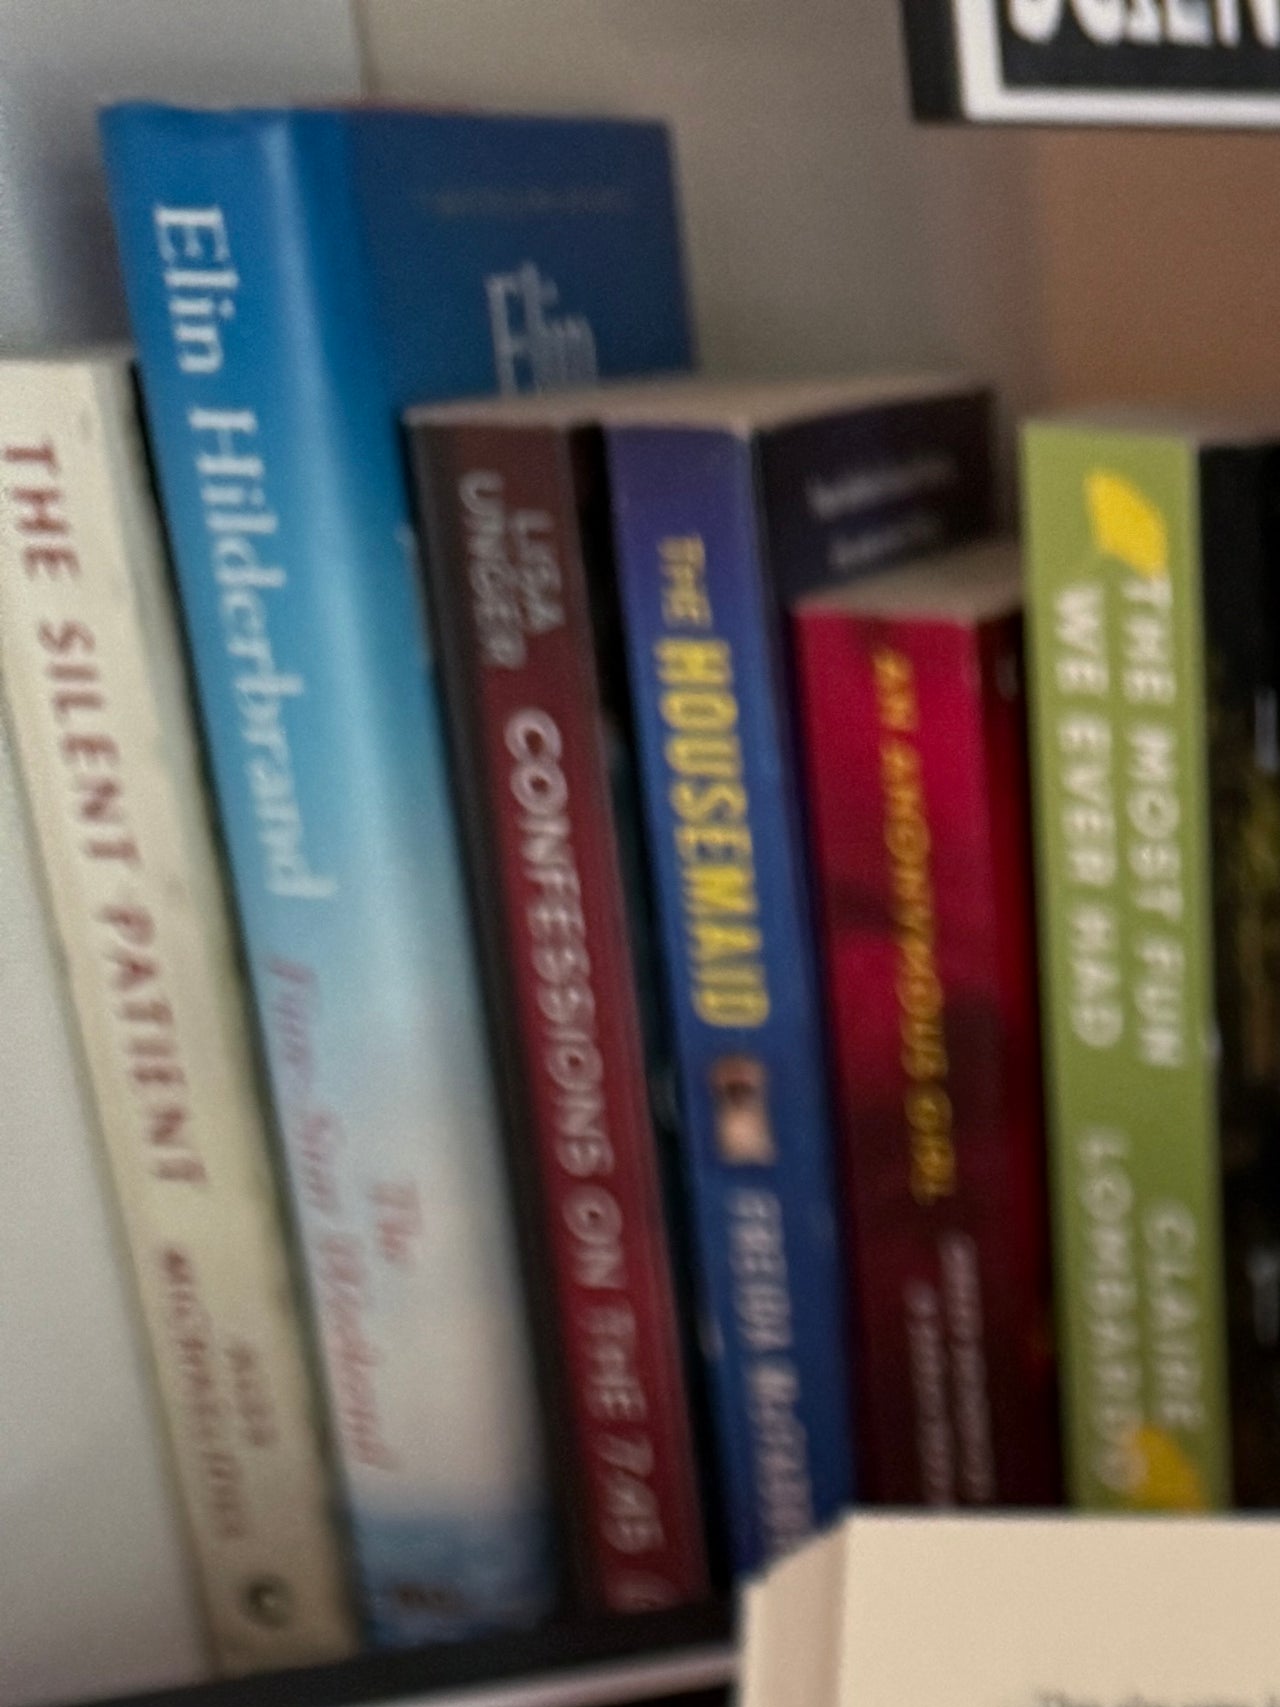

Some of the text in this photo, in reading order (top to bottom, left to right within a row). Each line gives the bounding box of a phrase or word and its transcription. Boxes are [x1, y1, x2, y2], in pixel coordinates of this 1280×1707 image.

[153, 194, 340, 910] Elin Hilderbrand
[657, 533, 765, 1032] THE HOUSEMAID
[2, 432, 203, 1198] THE SILENT PATIENT
[503, 704, 612, 1180] CONFESSIONS
[875, 740, 948, 1080] ANONYMOUS
[1050, 583, 1123, 1050] WE EVER HAD
[1115, 572, 1188, 1070] THE MOST FUN
[565, 1185, 626, 1292] ON
[579, 1303, 644, 1424] THE
[1142, 1211, 1202, 1432] CLAIRE
